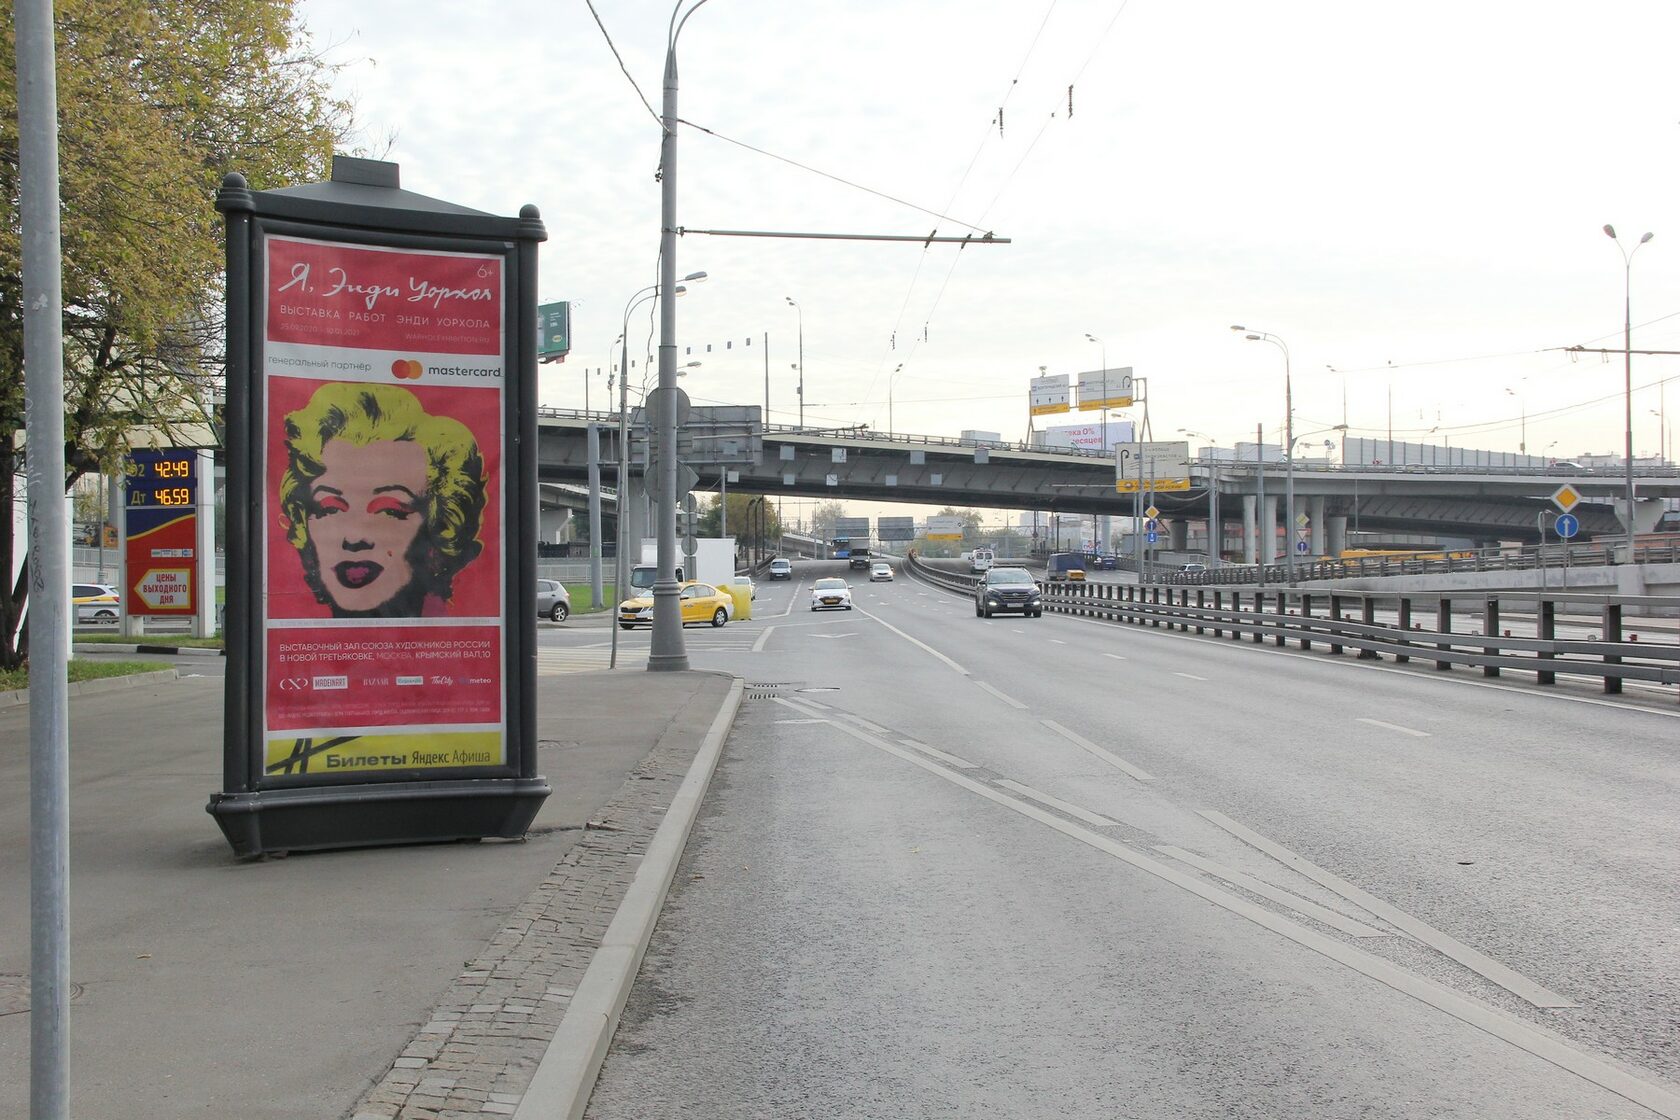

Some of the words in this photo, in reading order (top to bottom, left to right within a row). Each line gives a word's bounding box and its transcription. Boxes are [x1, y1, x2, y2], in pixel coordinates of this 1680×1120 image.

[477, 264, 493, 279] 6+
[278, 262, 314, 293] Я,
[323, 267, 399, 310] Энди
[407, 276, 492, 309] Уорхол
[279, 304, 341, 320] ВЫСТАВКА
[348, 311, 386, 323] РАБОТ
[396, 314, 430, 326] ЭНДИ
[436, 317, 491, 329] УОРХОЛА
[268, 355, 329, 369] генеральный
[330, 359, 372, 373] партнёр
[427, 364, 502, 378] mastercard
[154, 460, 189, 478] 42.49
[154, 488, 189, 505] 46.59
[279, 641, 343, 652] ВЫСТАВОЧНЫЙ
[344, 641, 360, 651] ЗАЛ
[361, 641, 394, 651] СОЮЗА
[395, 640, 452, 650] ХУДОЖНИКОВ
[453, 640, 491, 649] РОССИИ
[279, 653, 285, 662] В
[286, 651, 318, 662] НОВОЙ
[319, 651, 375, 661] ТРЕТЬЯКОВКЕ,
[415, 649, 462, 659] КРЫМСКИЙ
[326, 752, 408, 769] Билеты
[411, 750, 449, 765] Яндекс
[452, 748, 491, 764] Афиша
